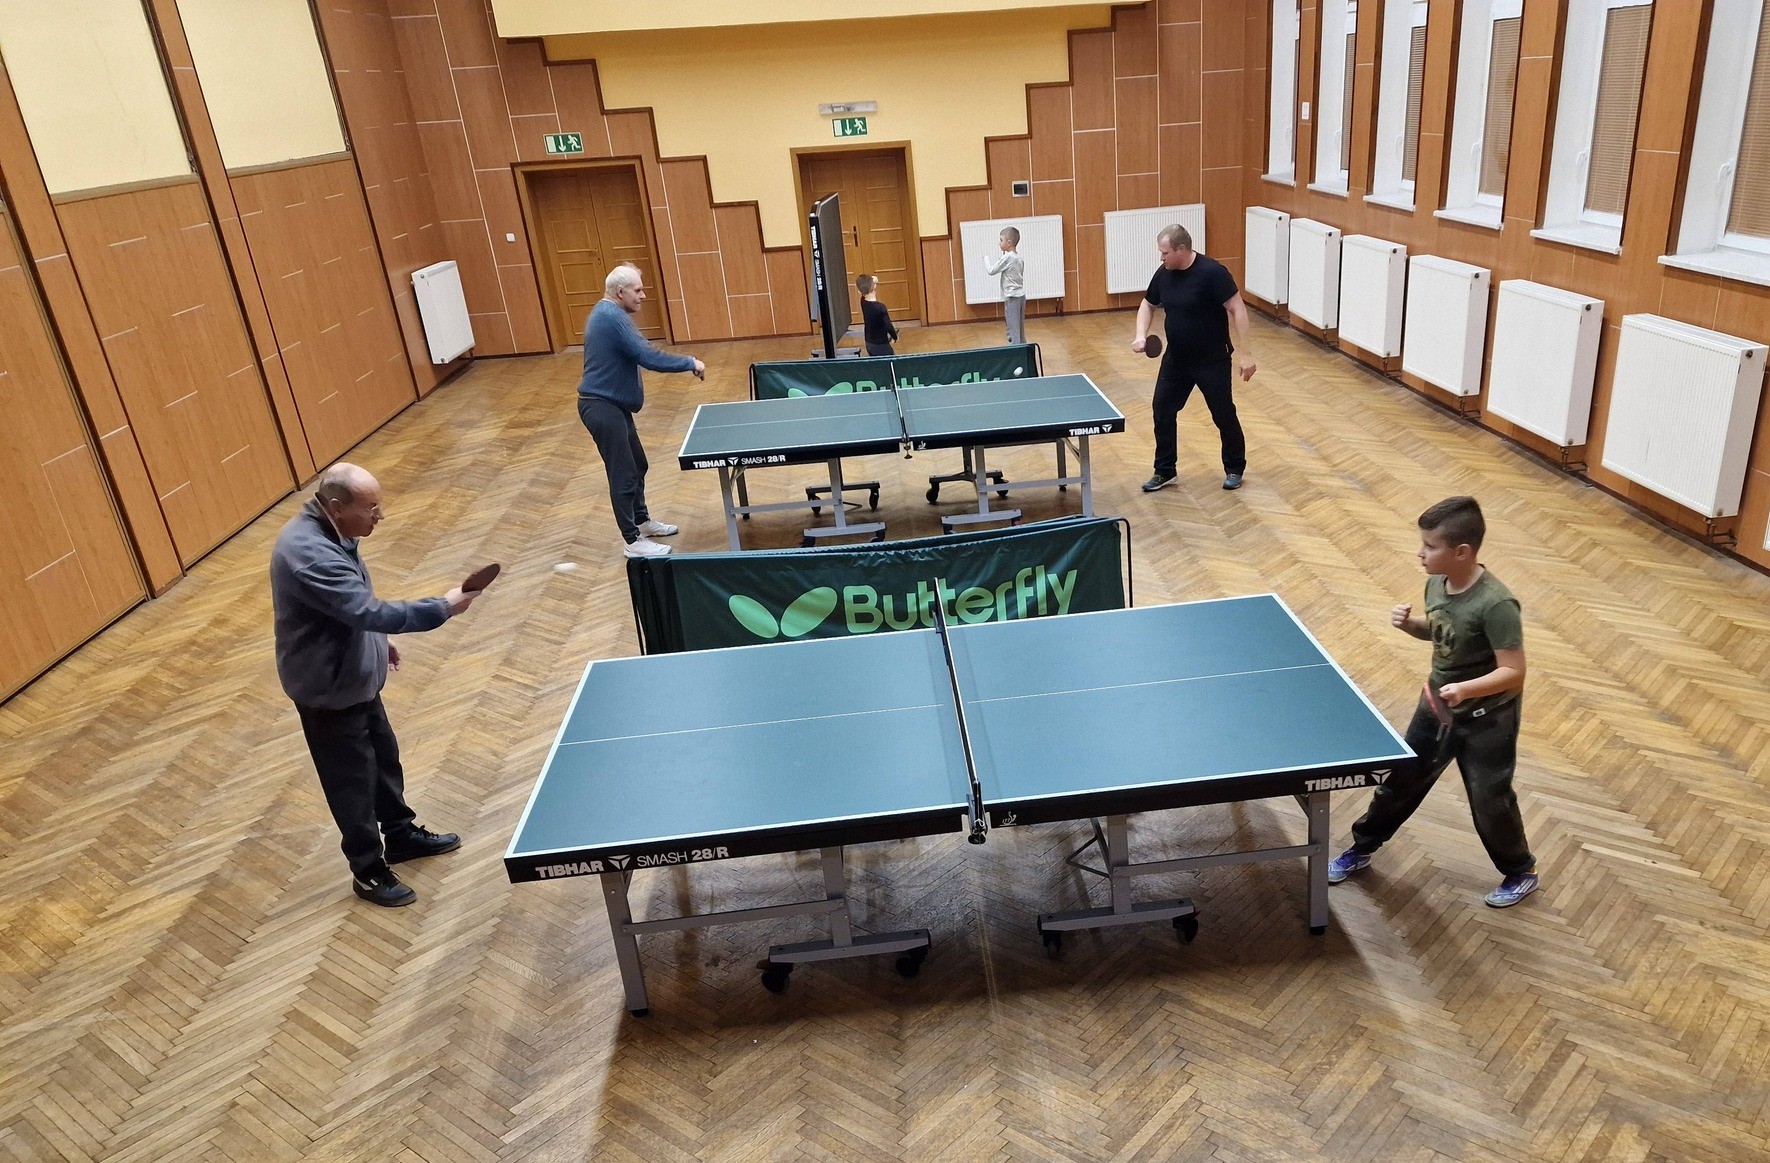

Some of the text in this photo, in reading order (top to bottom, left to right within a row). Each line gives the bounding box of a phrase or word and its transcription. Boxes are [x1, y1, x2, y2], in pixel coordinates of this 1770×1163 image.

[1068, 426, 1100, 436] TIBHAR
[692, 459, 726, 469] TIBHAR
[740, 456, 767, 465] SMASH
[843, 565, 1078, 634] Butterfly
[1304, 774, 1366, 792] TIBHAR
[535, 846, 730, 879] TIBHAR SMASH 28/R
